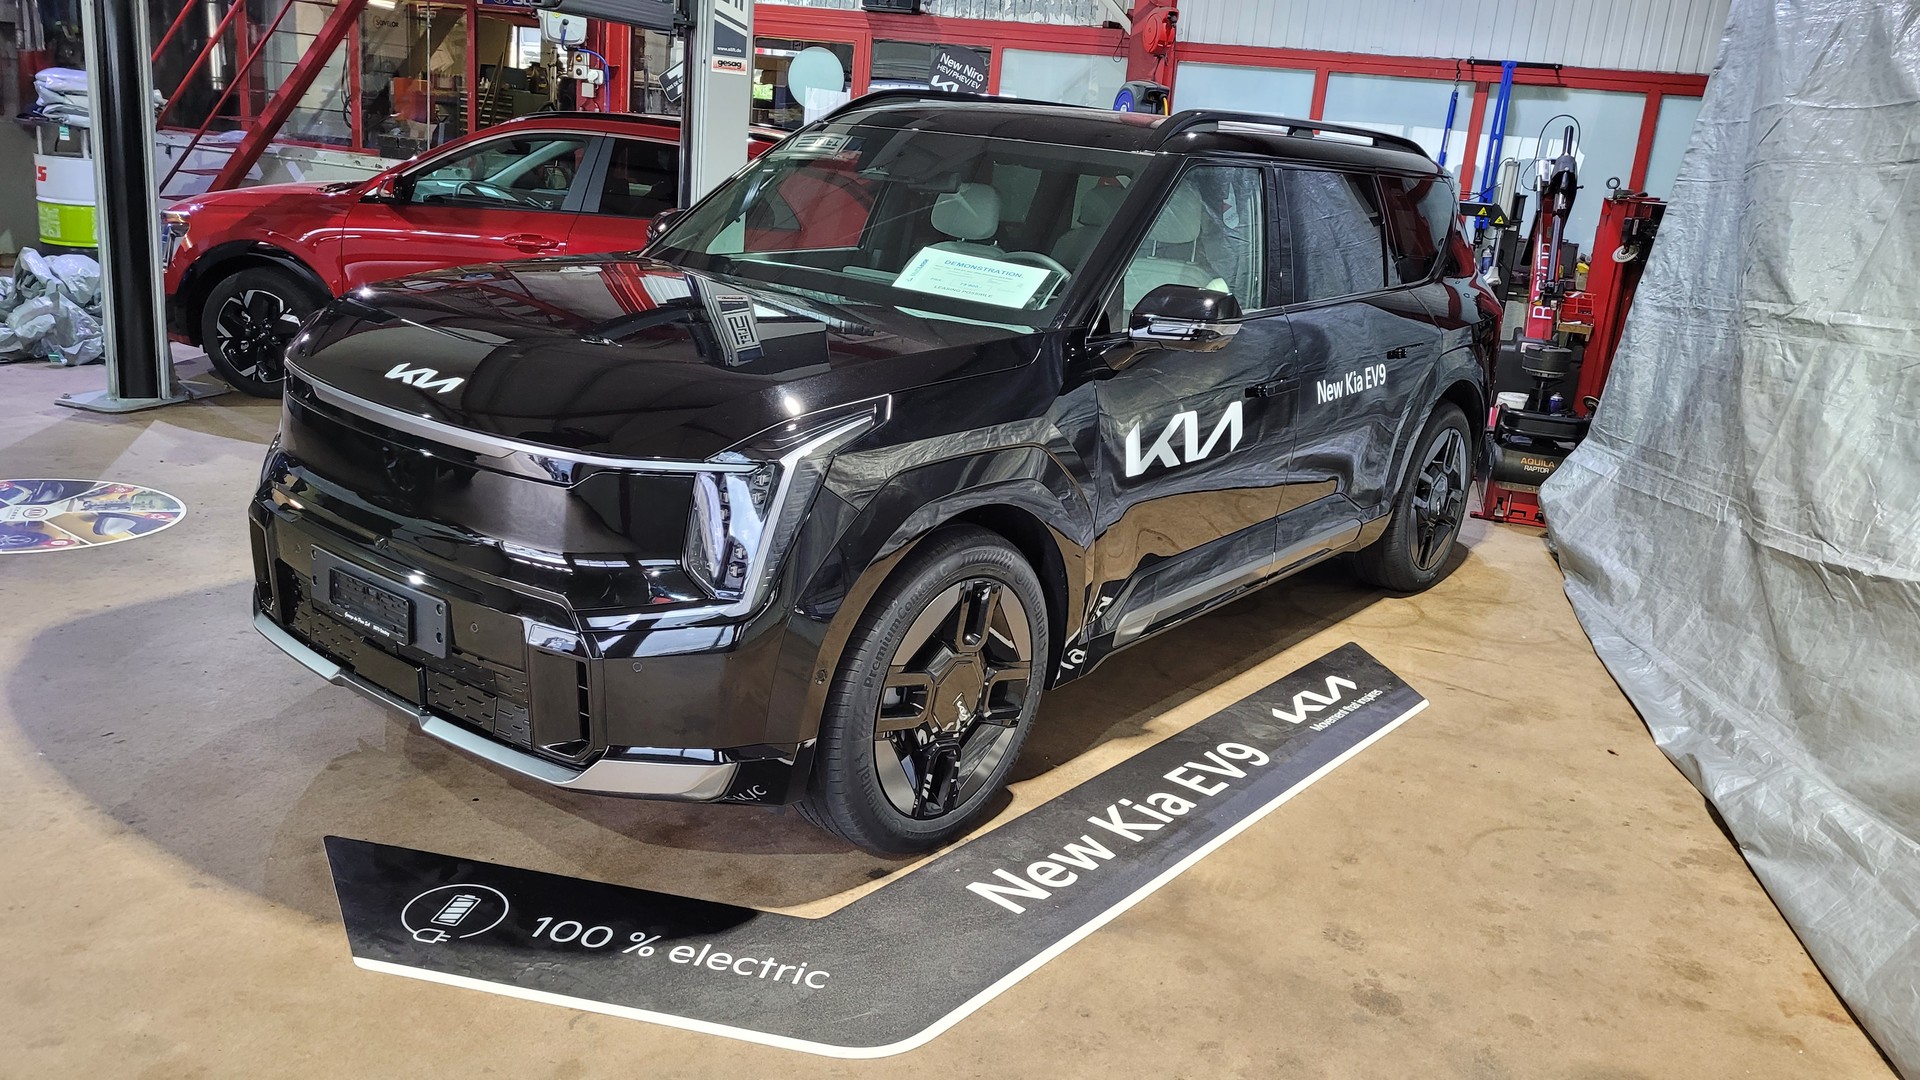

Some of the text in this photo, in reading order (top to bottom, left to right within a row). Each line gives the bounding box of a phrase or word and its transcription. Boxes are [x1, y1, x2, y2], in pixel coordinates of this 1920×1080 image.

[717, 59, 742, 70] gesag
[936, 63, 981, 90] HEV/PHEV/EV
[940, 52, 984, 82] New Niro
[384, 362, 465, 394] KIA
[1316, 363, 1387, 405] New Kia EV9
[1125, 400, 1243, 478] KIA
[1520, 457, 1555, 468] AQUILA
[1523, 464, 1549, 474] RAPTOR
[1271, 675, 1358, 724] KIA
[965, 742, 1271, 914] New Kia EV9
[531, 916, 831, 989] 100 % electric
